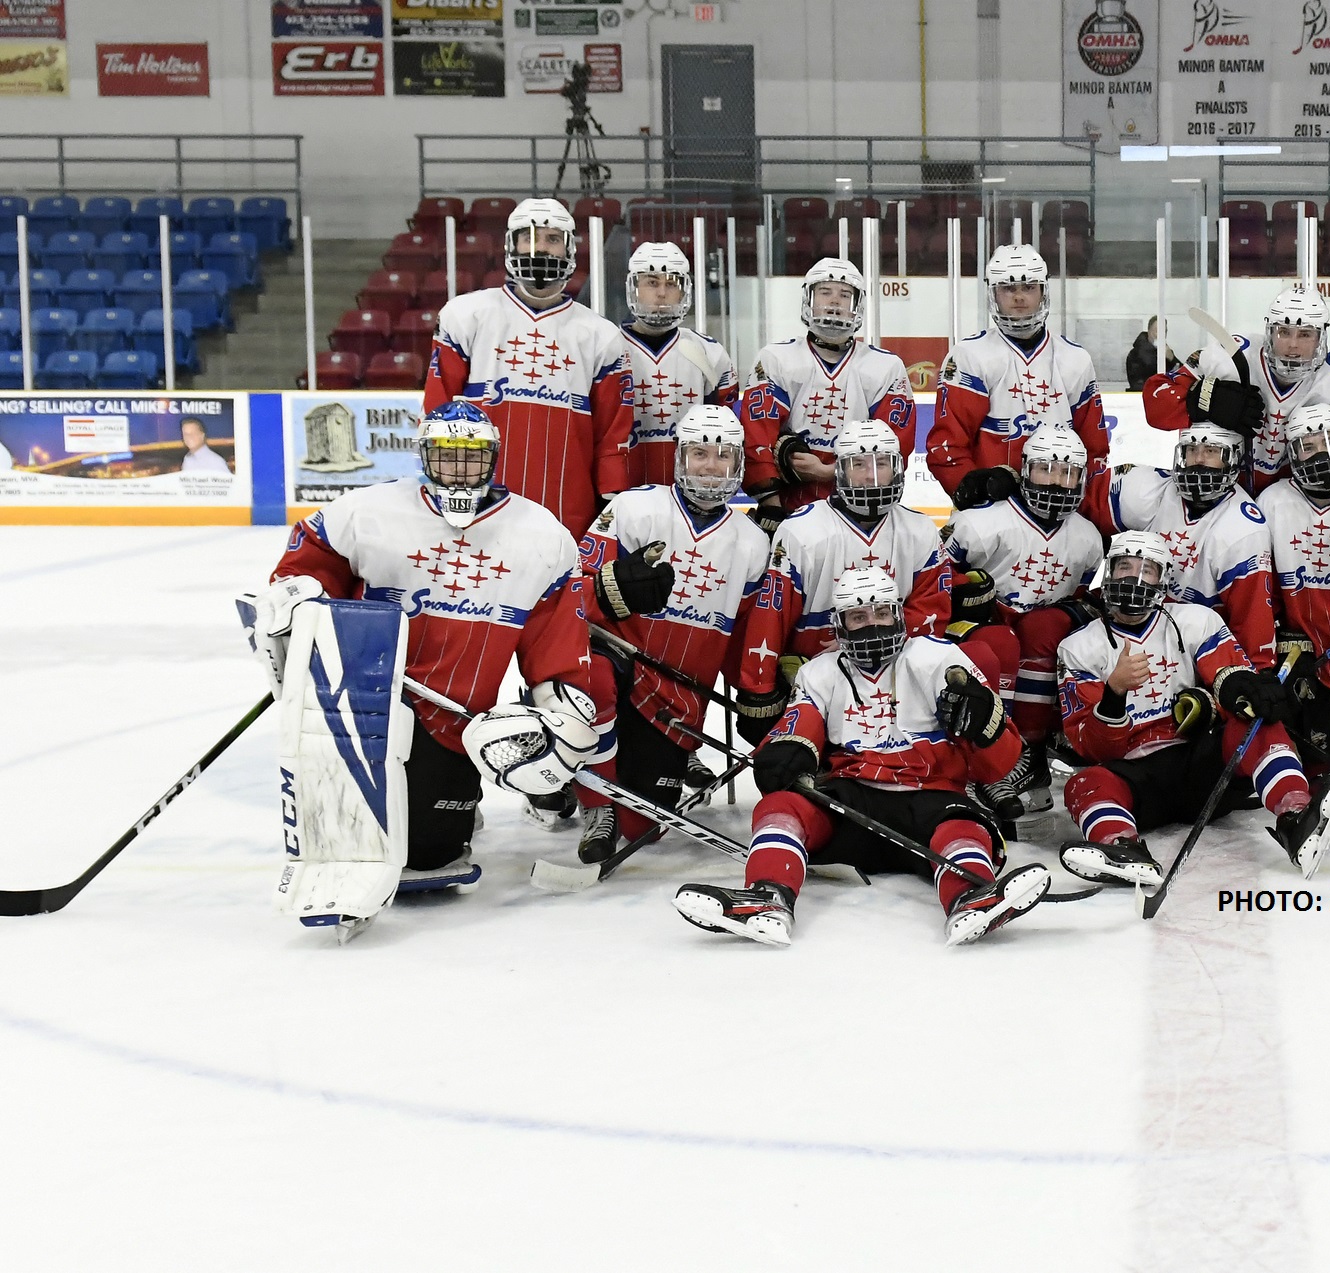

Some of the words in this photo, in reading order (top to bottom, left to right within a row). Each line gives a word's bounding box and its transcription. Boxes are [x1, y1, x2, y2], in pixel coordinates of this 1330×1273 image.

[1083, 35, 1137, 47] OMHA
[1205, 35, 1249, 46] OMHA
[103, 53, 135, 74] Tim
[136, 52, 200, 74] Hortons
[280, 45, 379, 80] Erb
[1179, 60, 1215, 72] MINOR
[1219, 60, 1264, 72] BANTAM
[1069, 81, 1105, 94] MINOR
[1109, 81, 1152, 94] BANTAM
[1218, 81, 1225, 93] A
[1107, 97, 1114, 109] A
[1196, 101, 1247, 114] FINALISTS
[1188, 122, 1215, 135] 2016
[1228, 122, 1255, 135] 2017
[1294, 124, 1321, 137] 2015
[482, 377, 570, 406] Snowbirds
[29, 400, 93, 414] SELLING?
[95, 401, 129, 414] CALL
[131, 401, 168, 415] MIKE
[182, 401, 222, 415] MIKE!
[366, 408, 417, 427] Bill's
[579, 536, 607, 570] 21
[407, 587, 494, 619] Snowbirds
[279, 765, 301, 858] CCM
[602, 783, 740, 855] TRUE
[943, 862, 965, 877] CCM
